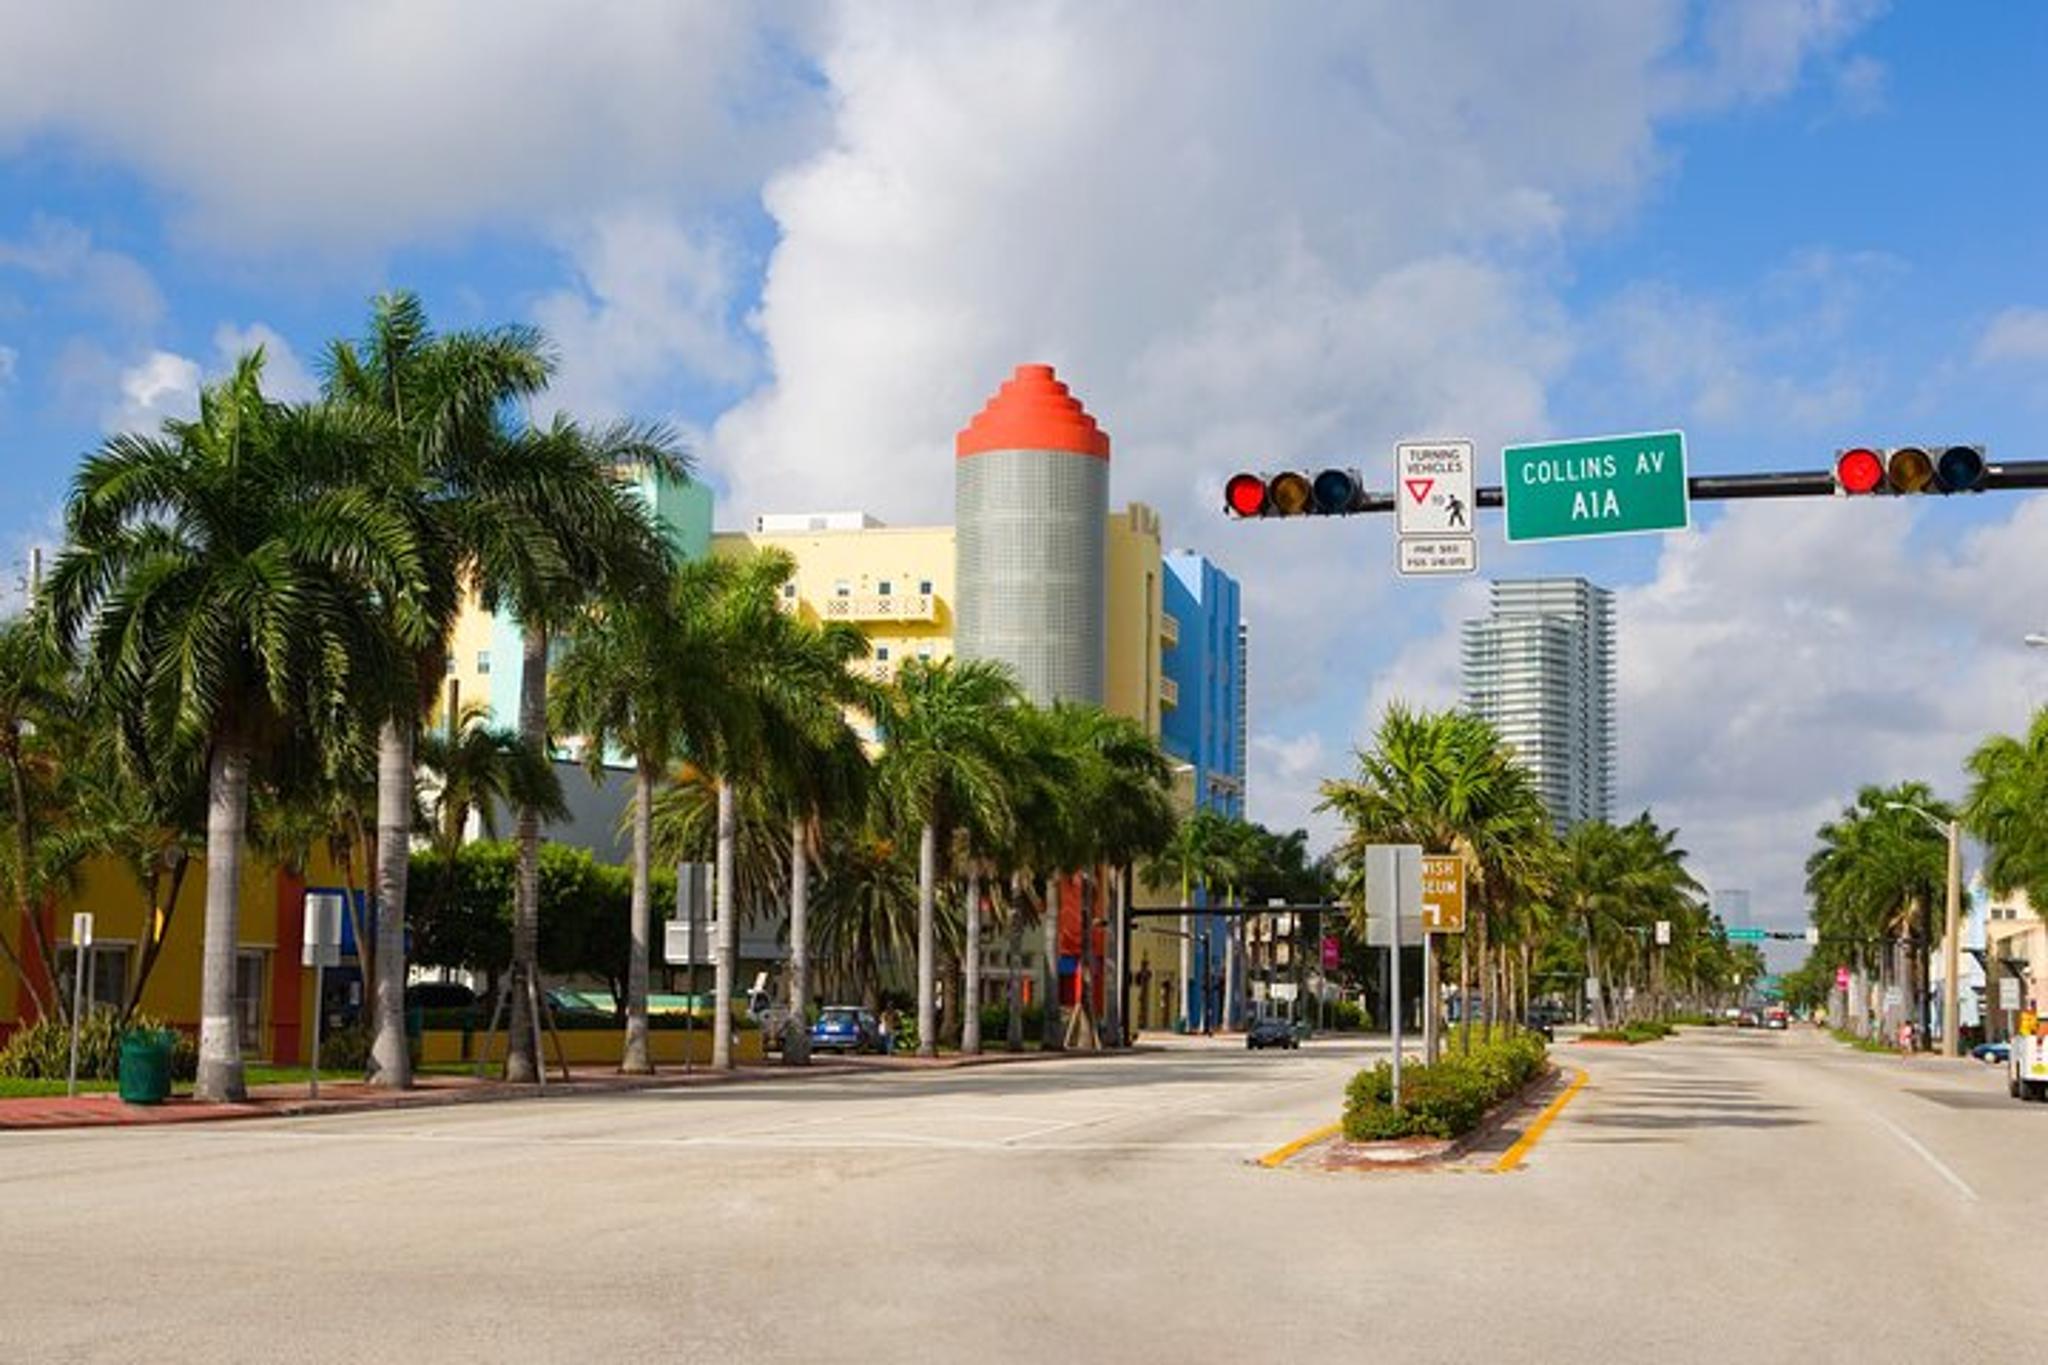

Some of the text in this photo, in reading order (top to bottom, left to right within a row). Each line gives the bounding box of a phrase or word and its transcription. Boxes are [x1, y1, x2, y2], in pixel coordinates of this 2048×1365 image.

[1409, 449, 1460, 461] TURNING
[1407, 462, 1463, 474] VEHICLES
[1523, 451, 1665, 484] COLLINS AV
[1572, 489, 1620, 520] A1A
